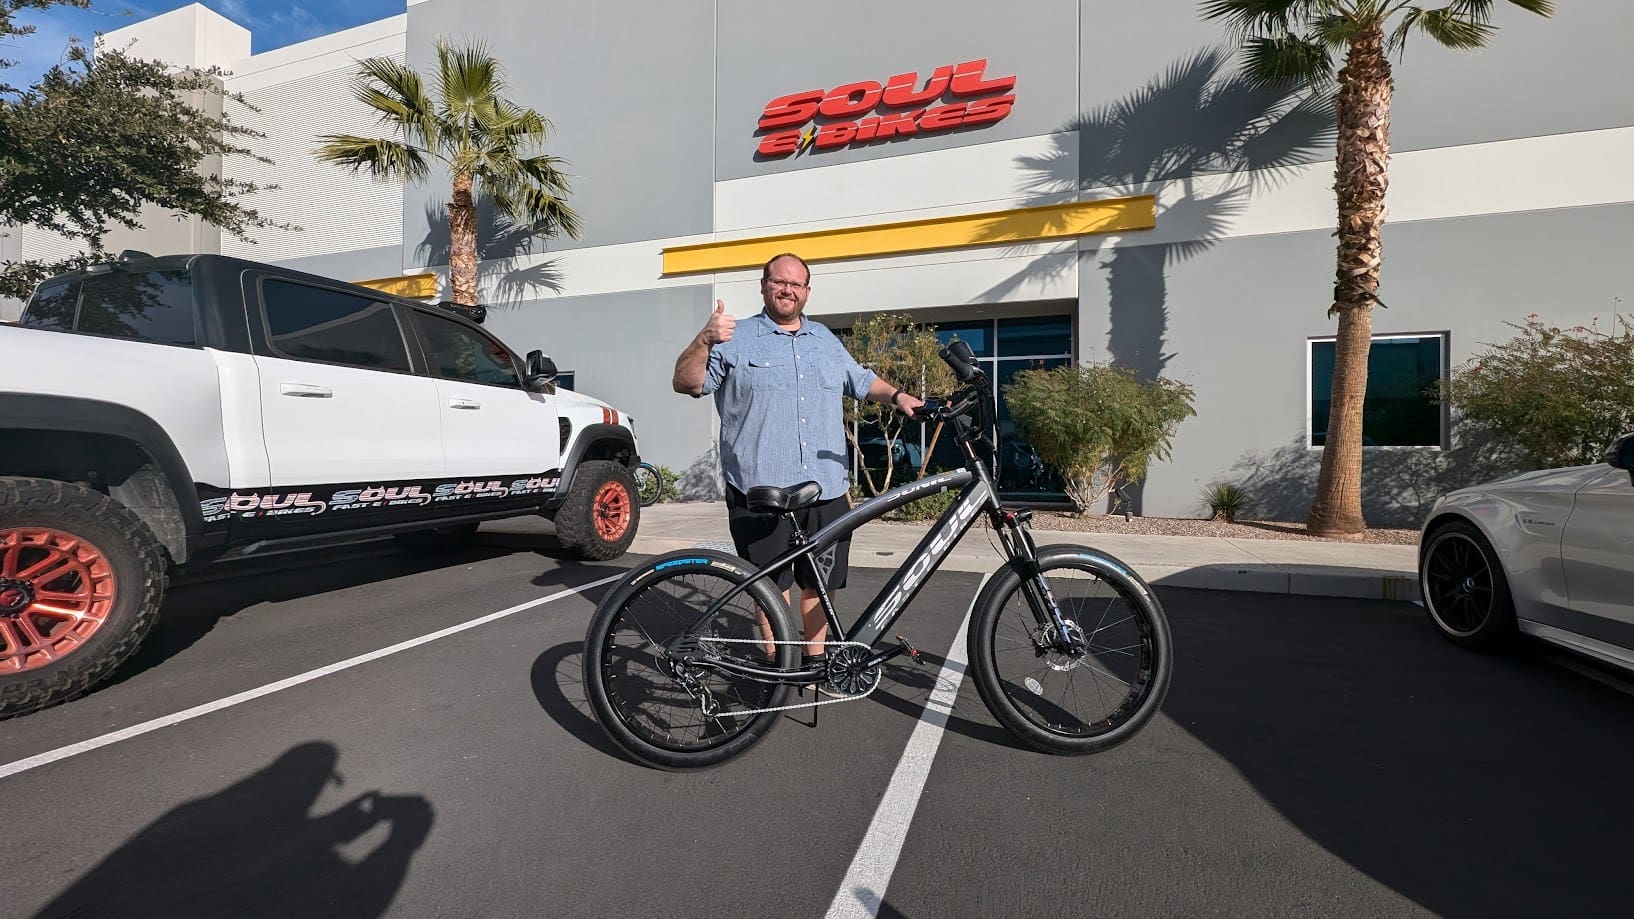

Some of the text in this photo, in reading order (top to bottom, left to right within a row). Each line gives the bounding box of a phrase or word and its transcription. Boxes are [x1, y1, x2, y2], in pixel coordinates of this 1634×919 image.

[758, 59, 1017, 130] SOUL
[328, 486, 431, 507] SOUL
[432, 480, 509, 498] SOUL
[200, 492, 326, 517] SOUL
[873, 490, 987, 631] SOUL
